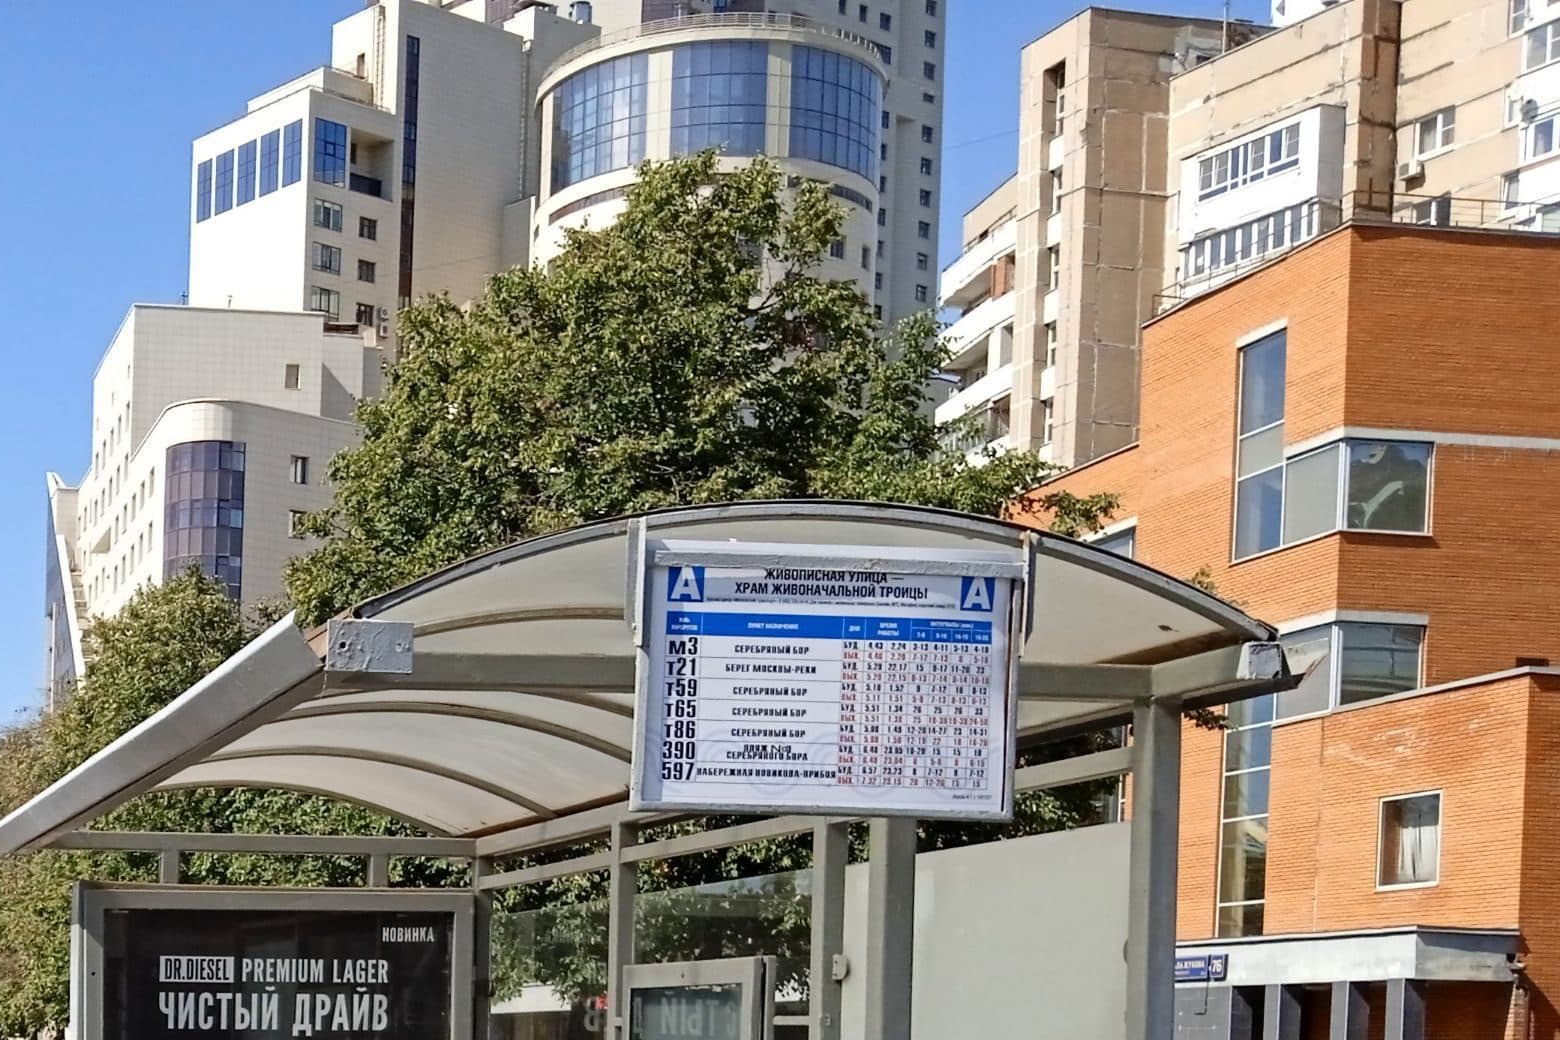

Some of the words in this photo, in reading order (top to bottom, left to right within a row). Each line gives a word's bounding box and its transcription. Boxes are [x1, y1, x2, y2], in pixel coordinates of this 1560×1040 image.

[765, 568, 844, 584] ЖИВОПИСНАЯ
[848, 571, 888, 585] УЛИЦА
[735, 583, 768, 595] ХРАМ
[771, 583, 876, 599] ЖИВОНАЧАЛЬНОЙ
[879, 586, 928, 601] ТРОИЦЫ
[734, 644, 791, 654] СЕРЕБРЯНЫЙ
[792, 646, 809, 655] БОР
[725, 663, 750, 673] БЕРЕГ
[732, 686, 788, 696] СЕРЕБРЯНЫЙ
[790, 688, 807, 697] БОР
[732, 707, 787, 717] СЕРЕБРЯНЫЙ
[789, 709, 806, 718] БОР
[731, 728, 787, 738] СЕРЕБРЯНЫЙ
[788, 729, 806, 739] БОР
[663, 741, 696, 760] 390
[662, 761, 695, 780] 597
[697, 767, 753, 777] НАБЕРЕЖНАЯ
[382, 926, 435, 943] НОВИНКА
[164, 957, 231, 982] DR.DIESEL
[241, 957, 324, 983] PREMIUM
[332, 959, 389, 984] LAGER
[159, 985, 279, 1031] ЧИСТЫЙ
[291, 986, 389, 1037] ДРАЙВ
